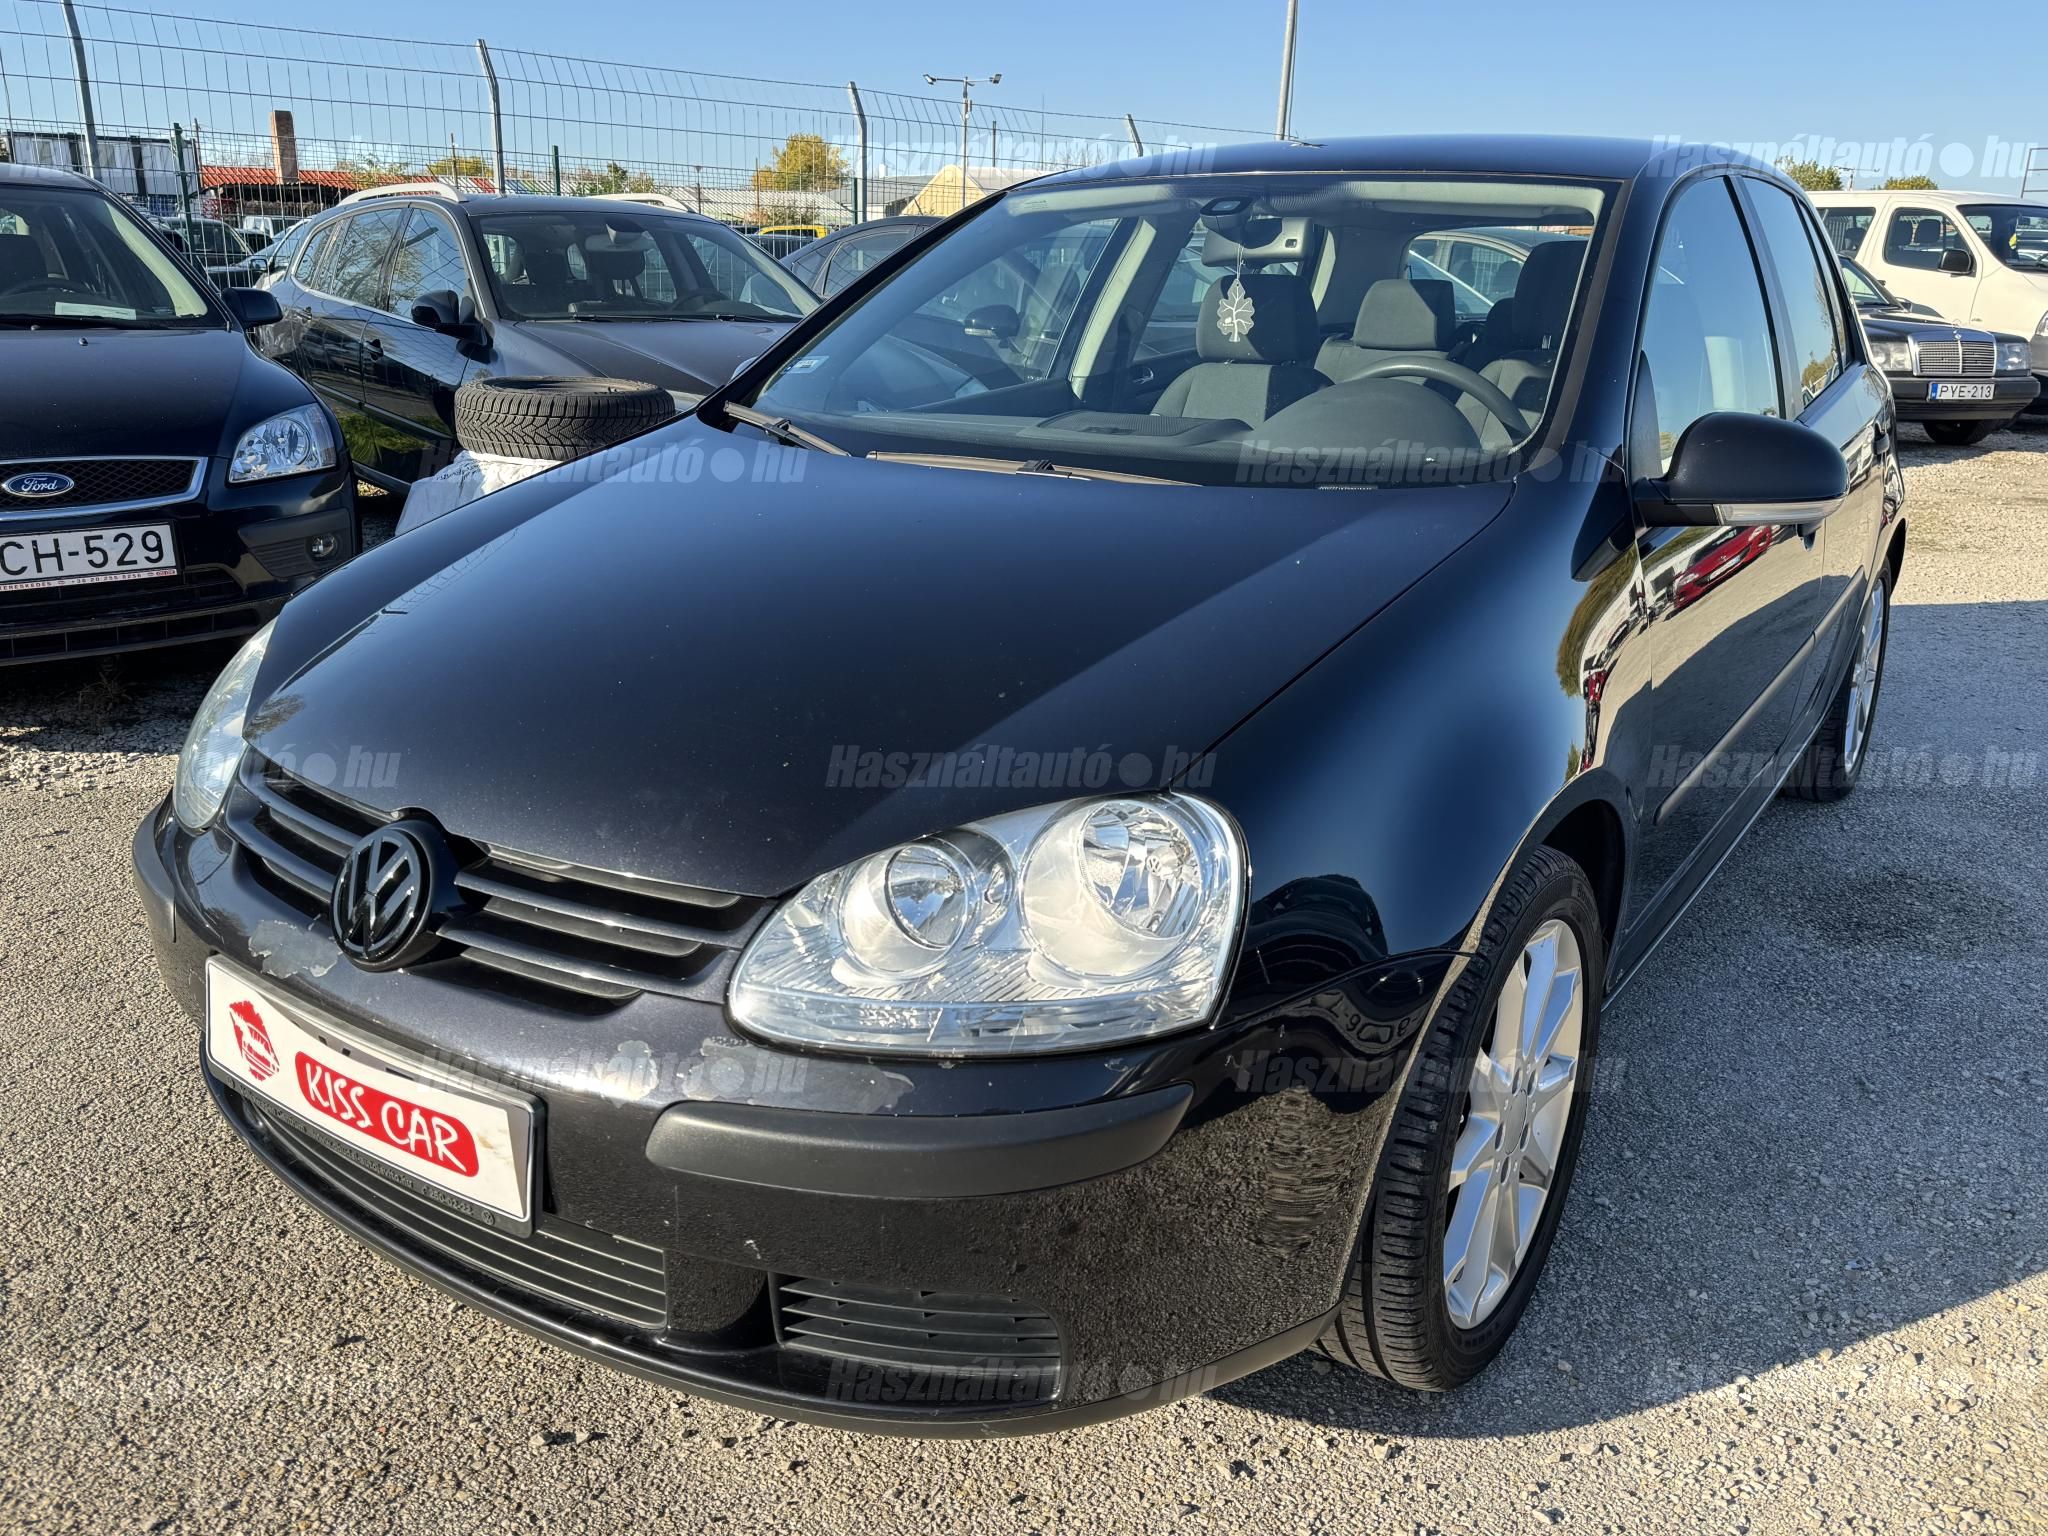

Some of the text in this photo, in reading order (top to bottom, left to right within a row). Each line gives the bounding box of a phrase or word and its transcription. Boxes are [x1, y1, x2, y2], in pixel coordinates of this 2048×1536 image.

[1939, 385, 1992, 398] PYE-213
[21, 477, 58, 492] Ford
[0, 530, 164, 576] CH-529
[306, 1062, 373, 1128] KISS
[381, 1100, 467, 1172] CAR
